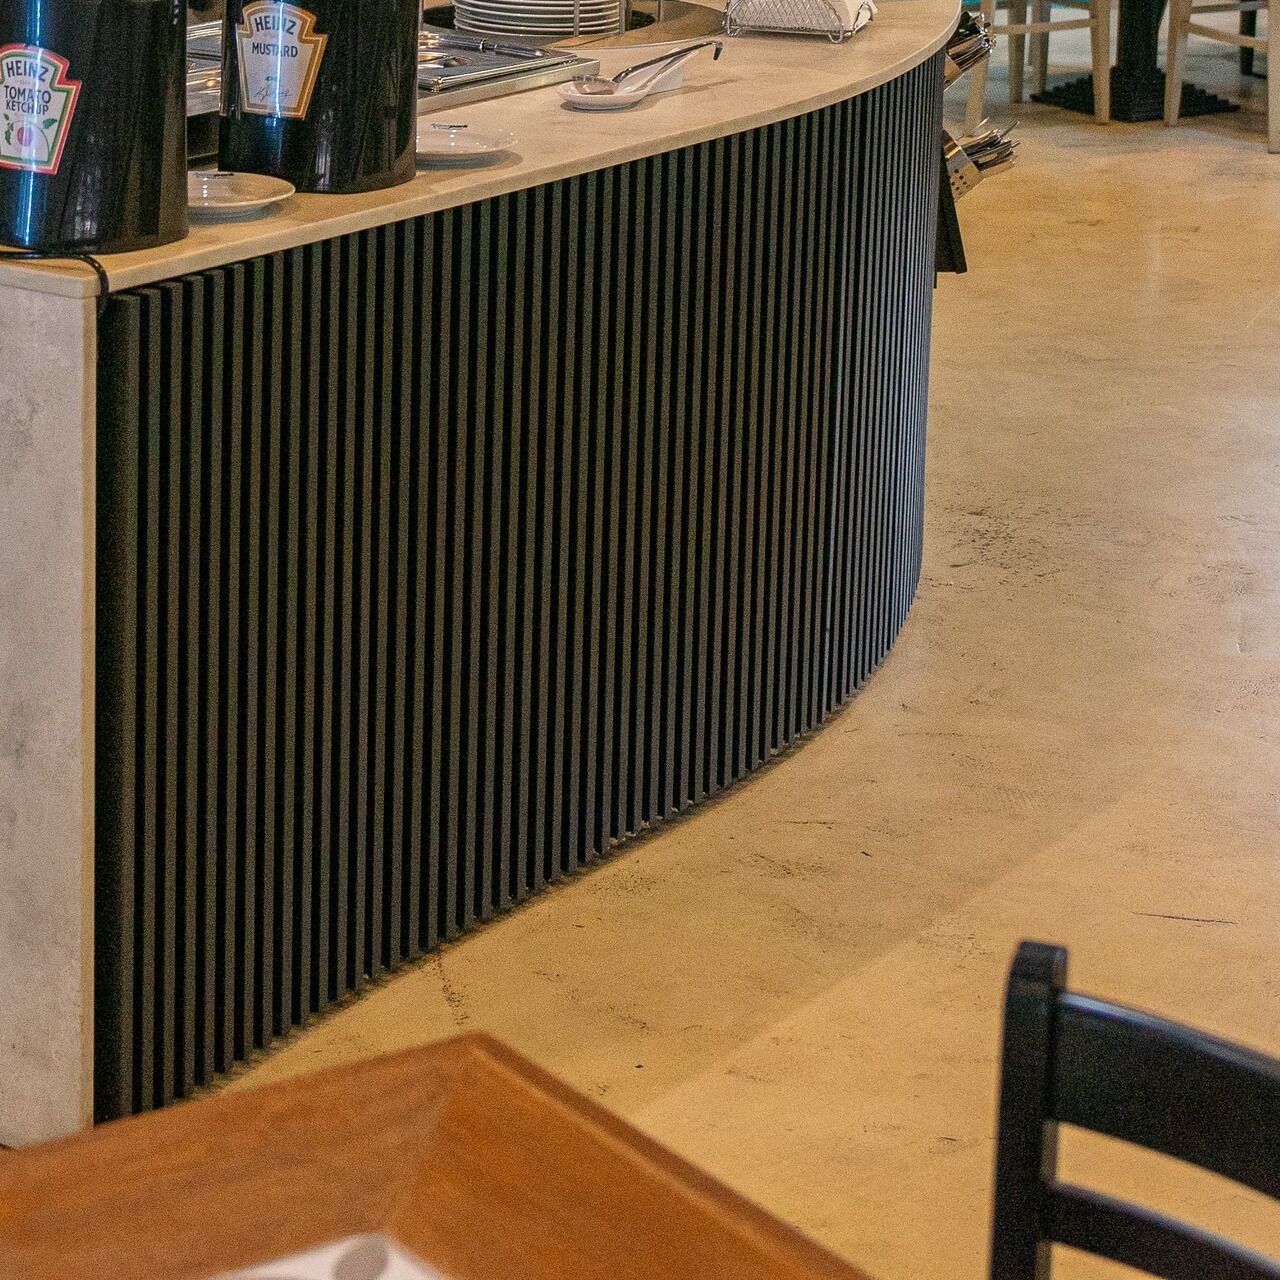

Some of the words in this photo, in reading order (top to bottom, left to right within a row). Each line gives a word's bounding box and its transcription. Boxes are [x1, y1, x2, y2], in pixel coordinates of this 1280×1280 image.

[254, 15, 297, 35] HEINZ
[252, 42, 298, 58] MUSTARD
[6, 60, 49, 82] HEINZ
[4, 85, 52, 104] TOMATO
[6, 100, 49, 116] KETCHUP
